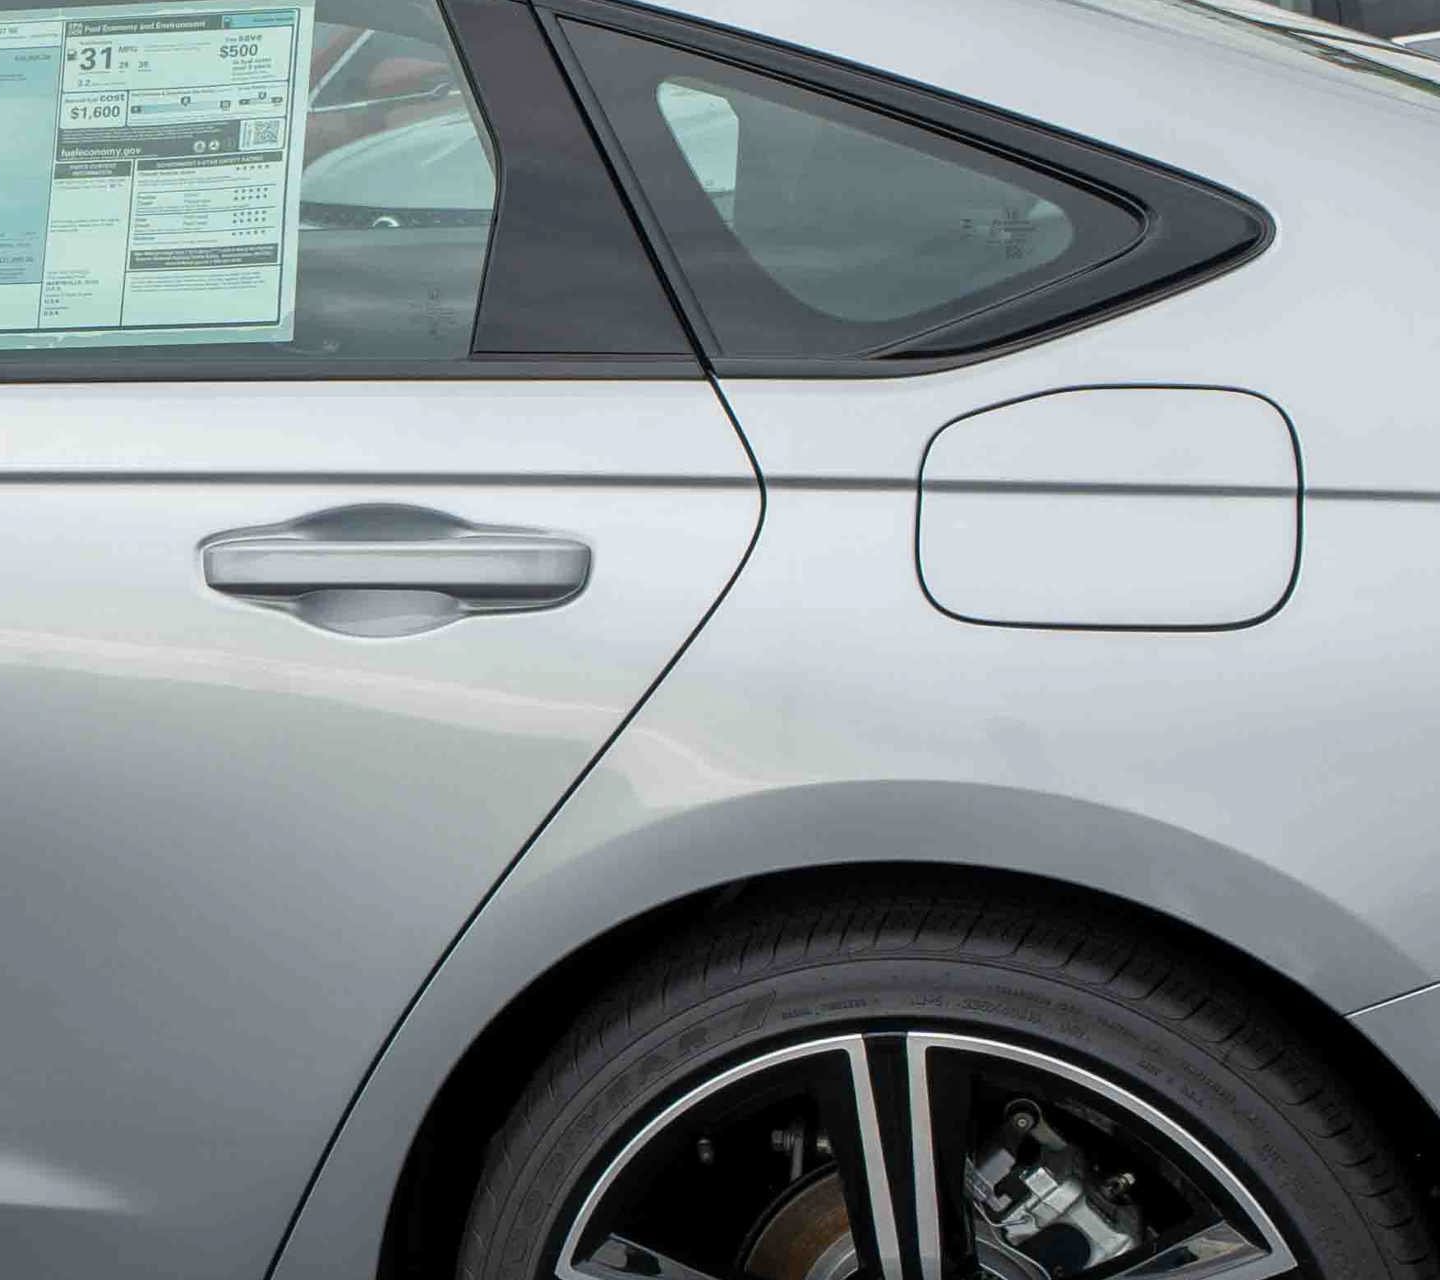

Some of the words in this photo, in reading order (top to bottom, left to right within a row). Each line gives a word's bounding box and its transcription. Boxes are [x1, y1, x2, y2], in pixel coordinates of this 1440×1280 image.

[79, 47, 113, 71] 31
[219, 44, 258, 59] $500
[100, 94, 125, 103] cost
[70, 105, 121, 120] $1,600
[61, 146, 141, 158] fueleconomy.gov
